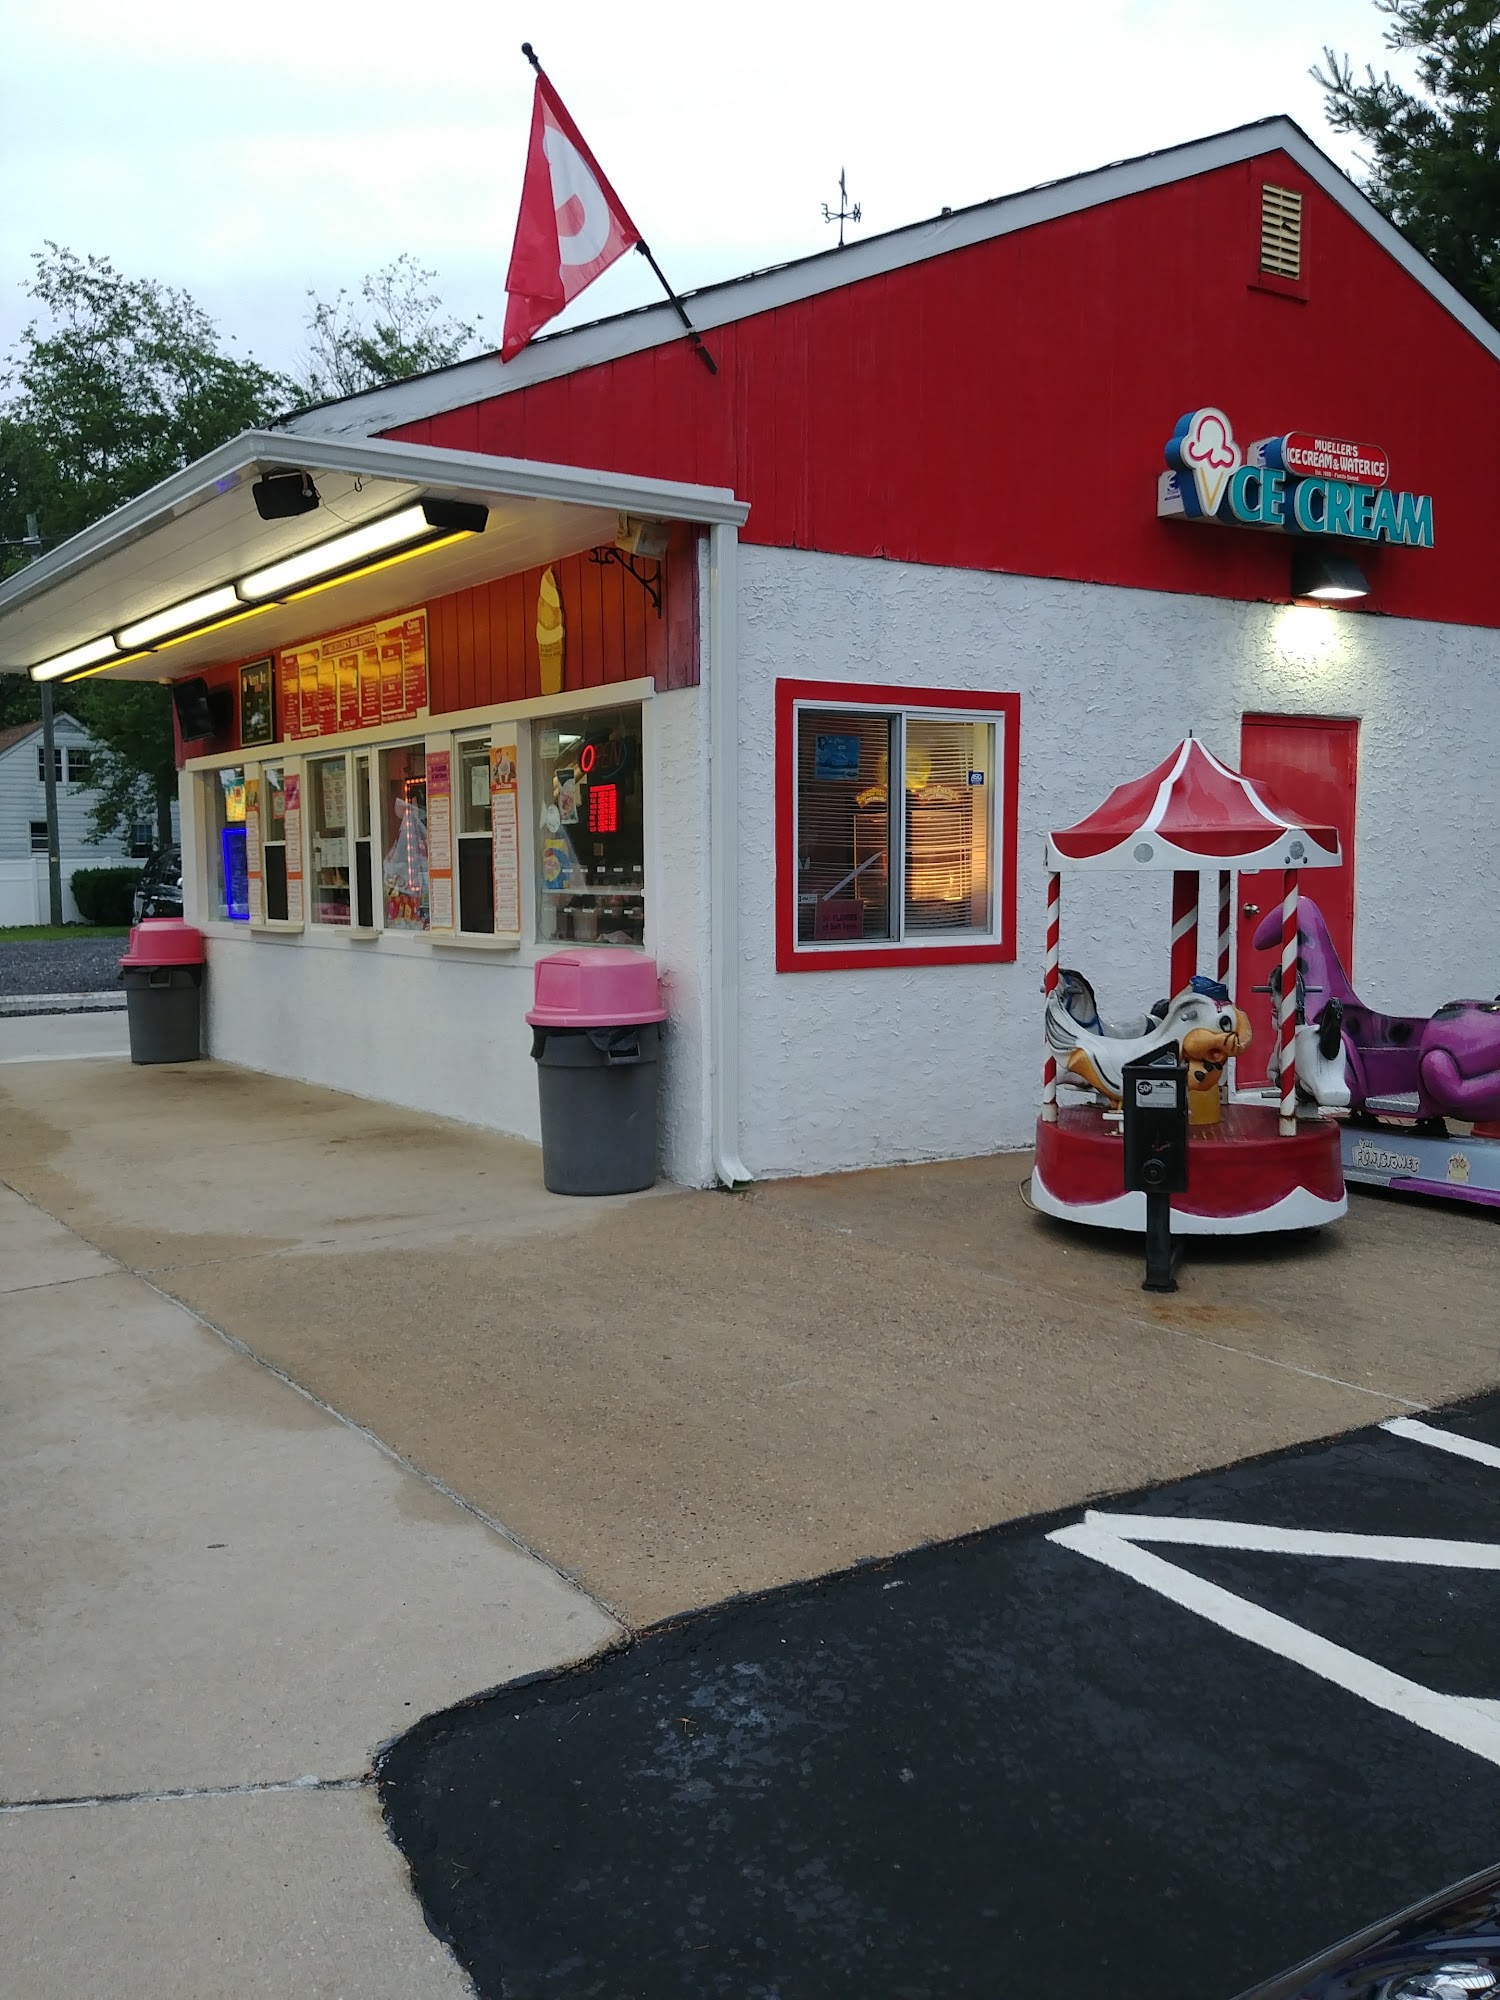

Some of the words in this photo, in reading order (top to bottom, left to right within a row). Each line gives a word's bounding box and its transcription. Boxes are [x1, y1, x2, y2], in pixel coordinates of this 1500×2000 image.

[1287, 447, 1301, 464] ICE
[1301, 449, 1333, 470] CREAM
[1332, 458, 1340, 470] &
[1339, 456, 1371, 475] WATER
[1371, 461, 1386, 478] ICE
[1314, 439, 1358, 457] MUELLER'S
[1296, 477, 1434, 549] CREAM
[580, 739, 622, 774] OPEN
[1352, 1146, 1420, 1173] FLINTSTONES
